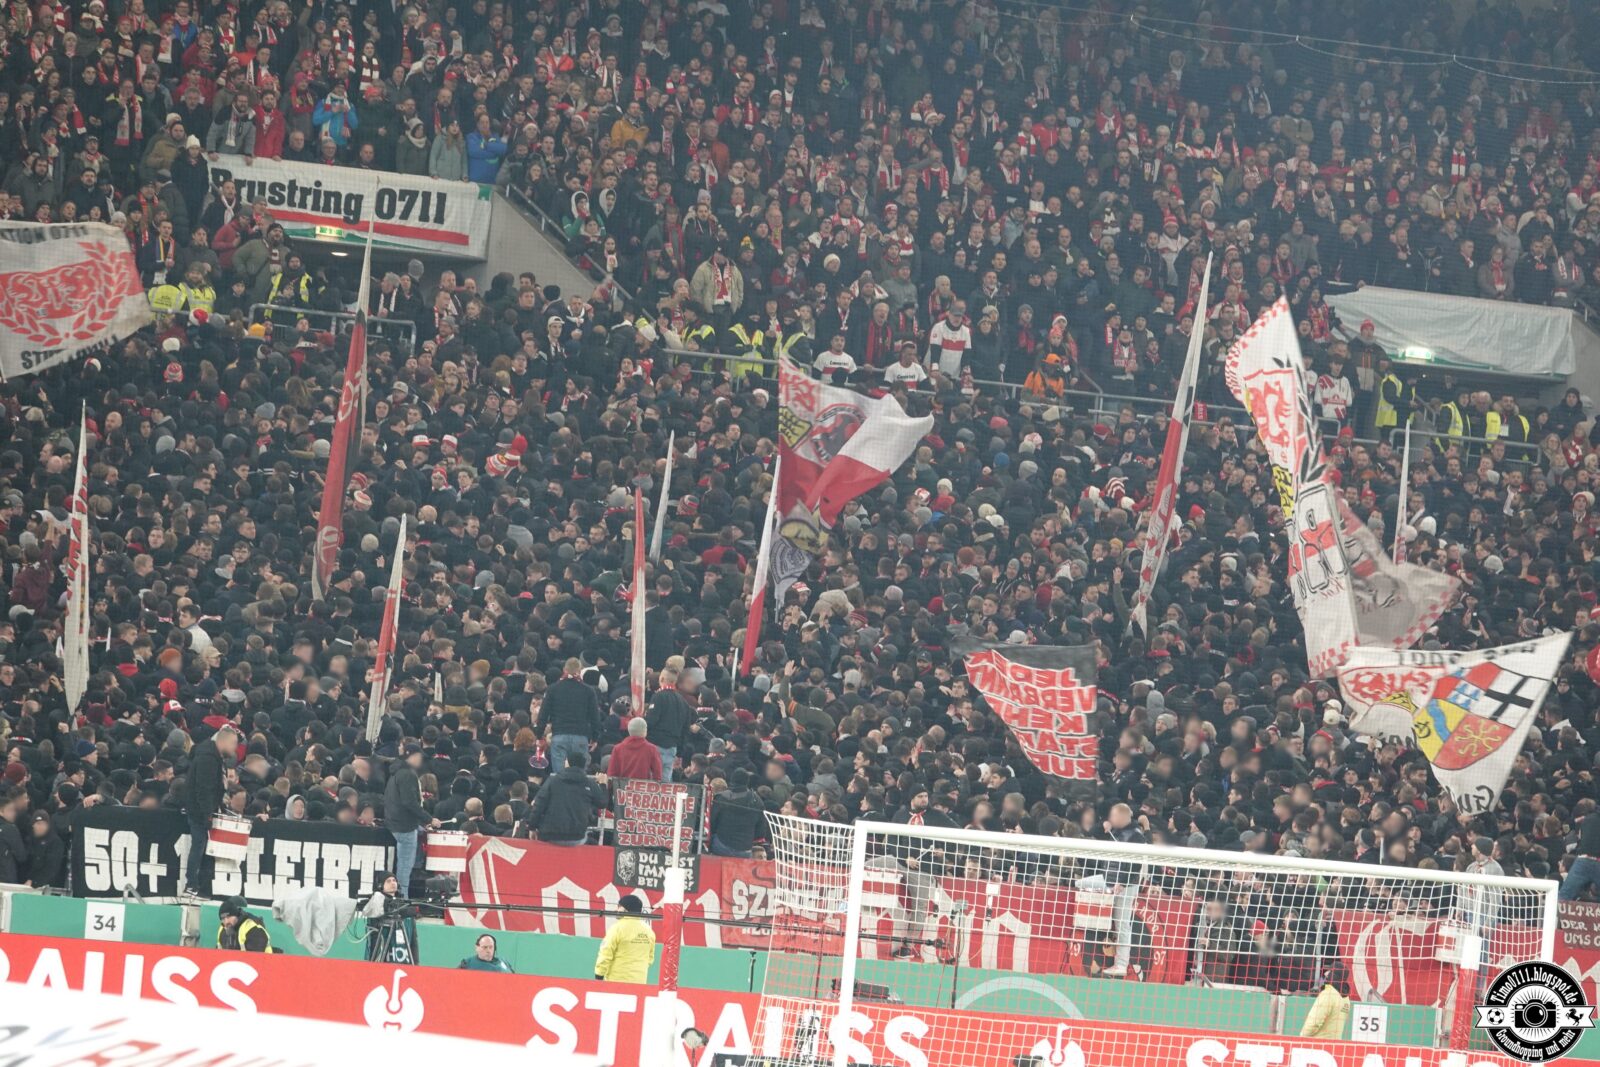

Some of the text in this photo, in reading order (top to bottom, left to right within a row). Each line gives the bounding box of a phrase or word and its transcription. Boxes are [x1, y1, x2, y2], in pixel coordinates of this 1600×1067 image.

[374, 187, 447, 225] 0711
[616, 788, 696, 813] VERBANNE
[639, 852, 695, 868] DU BST
[638, 864, 694, 881] IMMR
[638, 876, 659, 888] BEI
[93, 914, 117, 932] 34
[1560, 919, 1588, 932] DER
[1153, 950, 1167, 966] 97
[1359, 1016, 1380, 1033] 35
